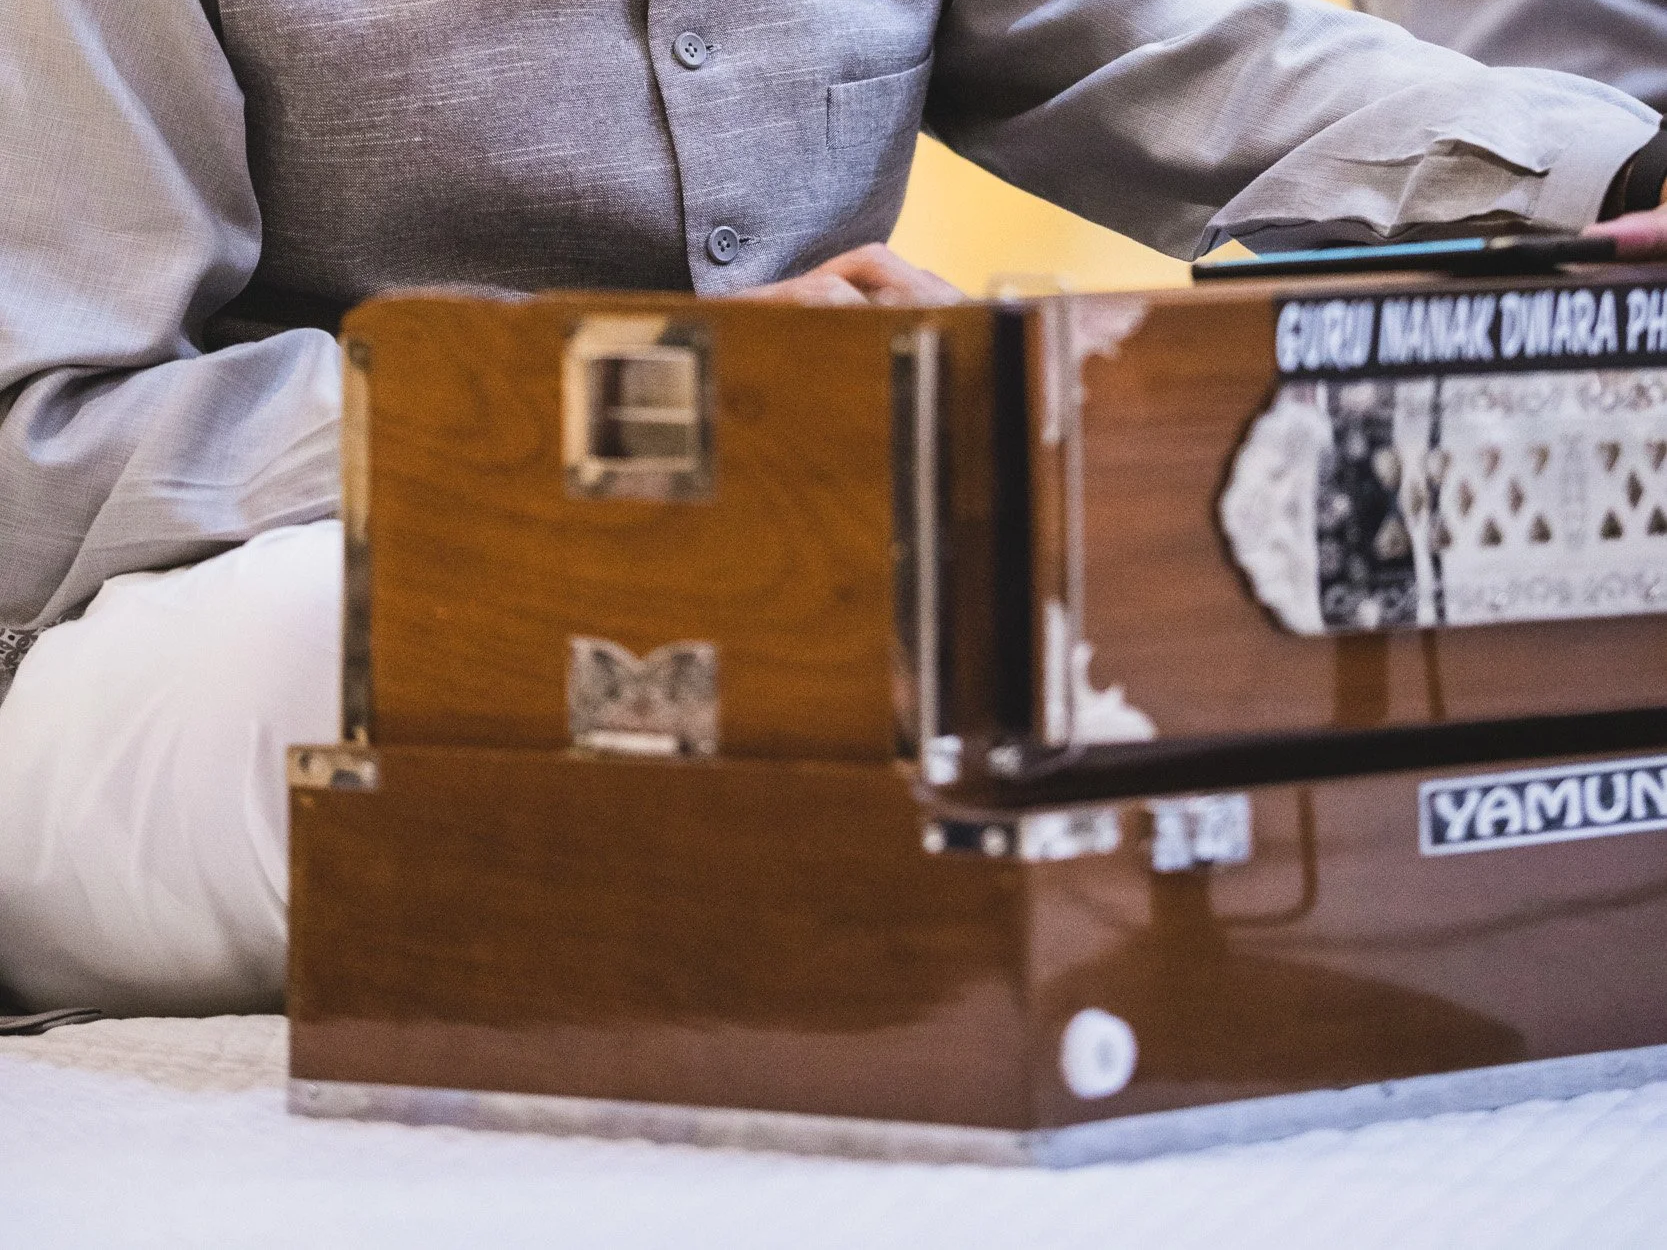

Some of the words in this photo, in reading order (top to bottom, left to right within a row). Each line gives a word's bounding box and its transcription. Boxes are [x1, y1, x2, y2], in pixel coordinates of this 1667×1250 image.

[1276, 299, 1375, 373] GURU
[1377, 293, 1497, 366] NANAK
[1499, 287, 1619, 359] DWARA
